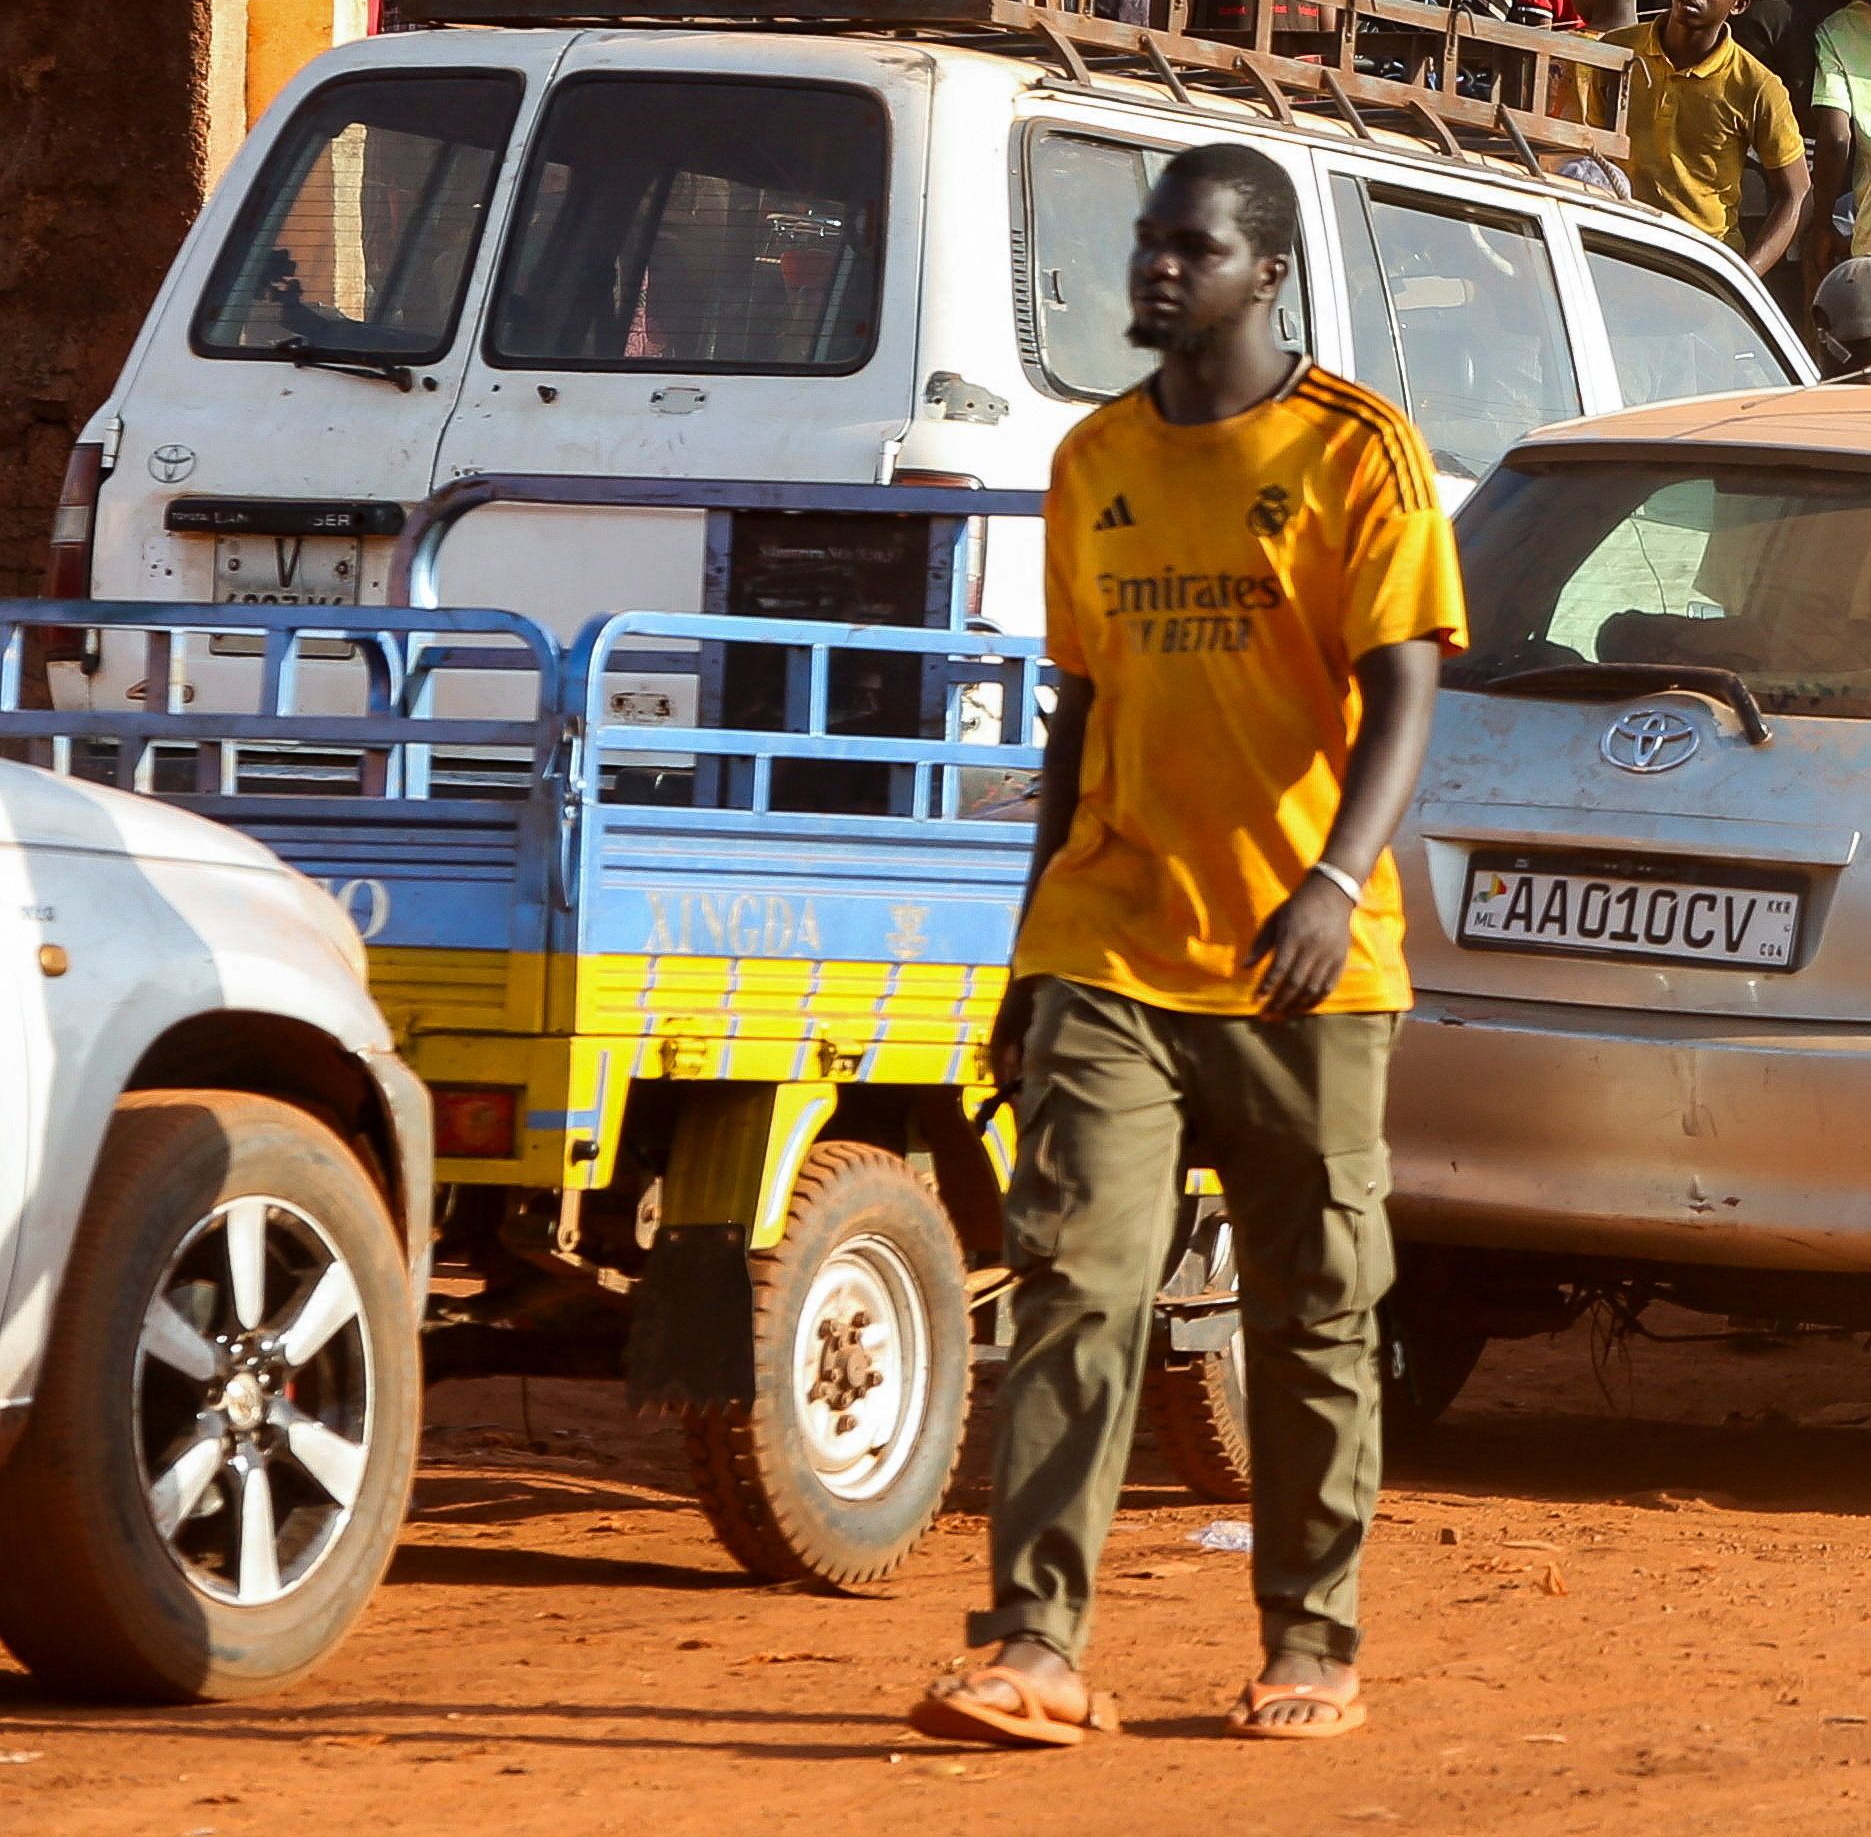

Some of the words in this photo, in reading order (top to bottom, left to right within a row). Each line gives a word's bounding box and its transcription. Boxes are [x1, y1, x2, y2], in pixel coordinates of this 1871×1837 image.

[1098, 564, 1281, 617] Emirates
[643, 889, 823, 958] XINGDA
[1474, 913, 1497, 929] ML
